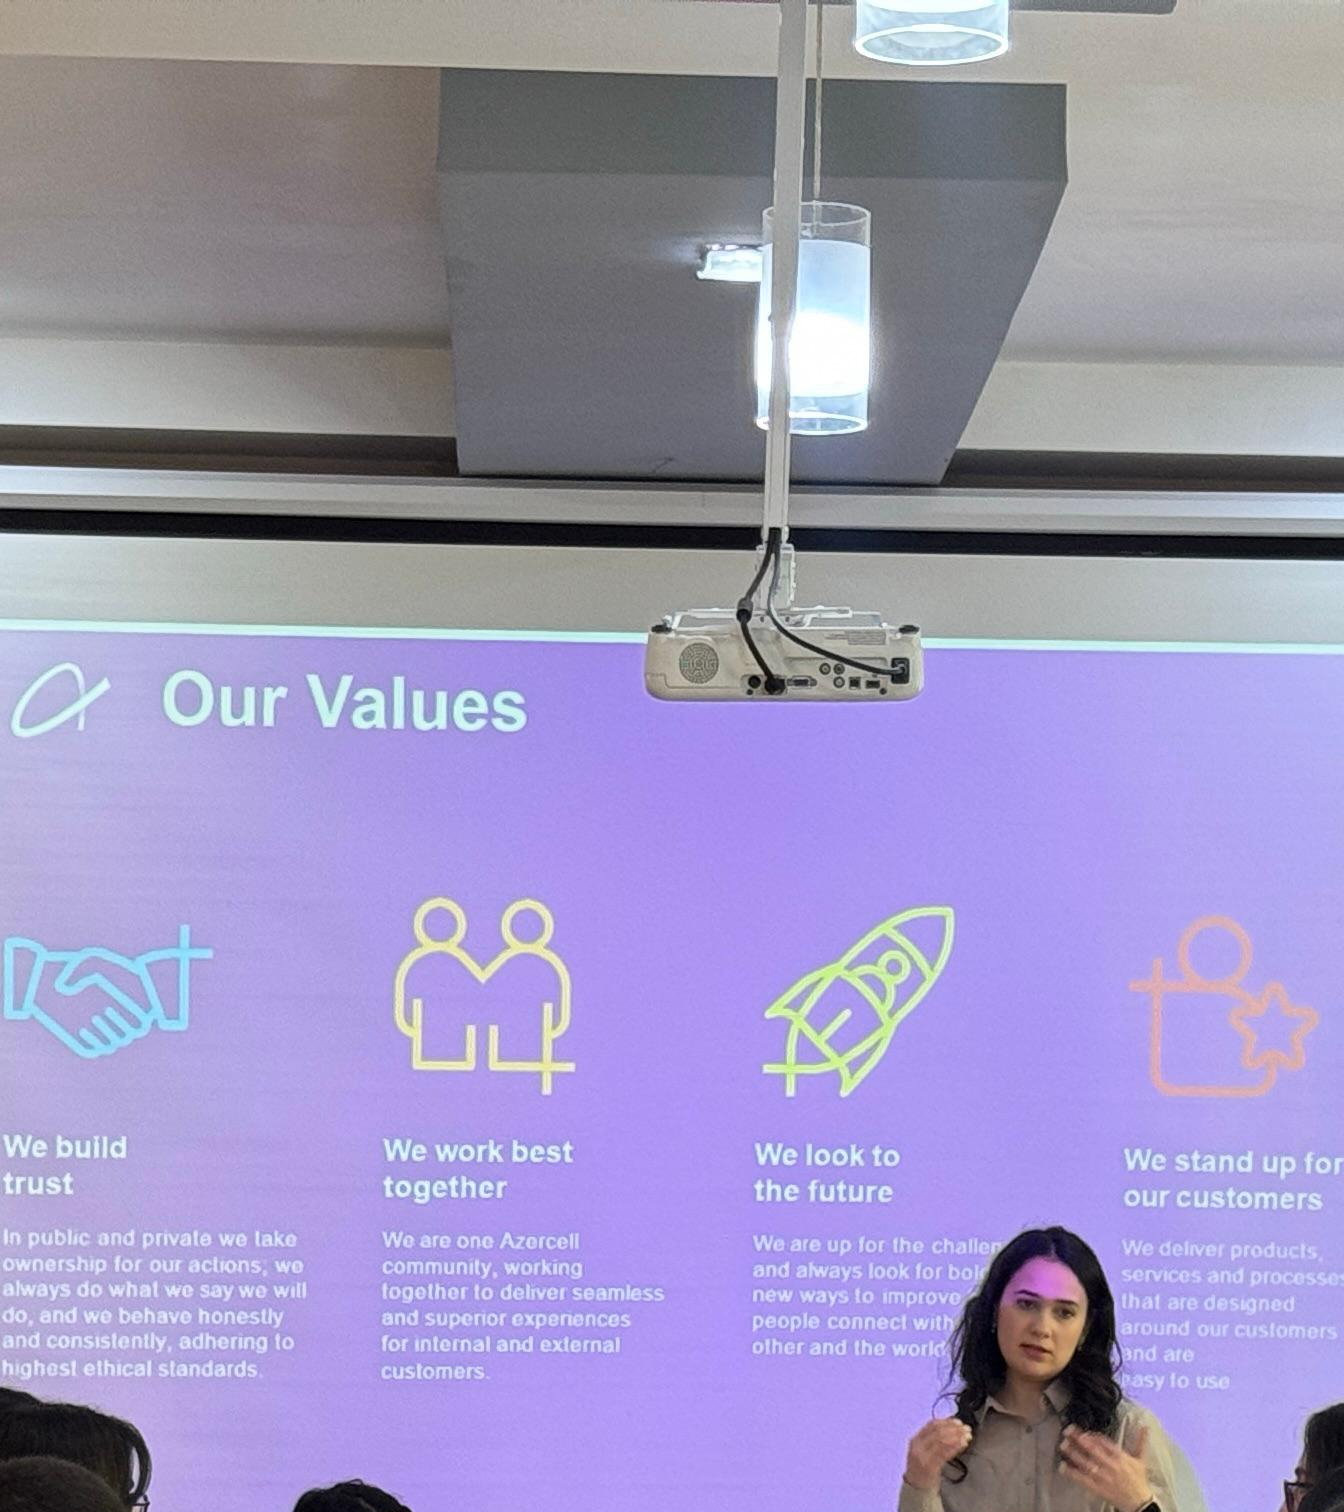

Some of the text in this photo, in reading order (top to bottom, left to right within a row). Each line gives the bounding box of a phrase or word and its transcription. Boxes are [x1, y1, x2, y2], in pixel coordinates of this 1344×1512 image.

[163, 670, 527, 732] Our Values
[4, 1135, 127, 1159] We build
[383, 1139, 573, 1163] We work best
[755, 1143, 900, 1167] We look to
[1124, 1149, 1344, 1179] We stand up for
[4, 1172, 74, 1195] trust
[383, 1176, 507, 1204] together
[755, 1179, 894, 1203] the future
[1124, 1188, 1324, 1210] our customers
[4, 1229, 297, 1249] In public and private we take
[382, 1232, 579, 1250] We are one Azercell
[753, 1235, 784, 1251] We
[790, 1239, 820, 1252] are
[828, 1240, 851, 1256] up
[859, 1237, 885, 1252] for
[893, 1237, 924, 1253] the
[1122, 1240, 1153, 1256] We
[1159, 1241, 1224, 1258] deliver
[3, 1256, 106, 1275] ownership
[114, 1256, 141, 1272] for
[150, 1259, 181, 1273] our
[275, 1260, 304, 1274] we
[382, 1258, 583, 1280] community, working
[753, 1262, 790, 1278] and
[796, 1263, 863, 1282] always
[869, 1263, 908, 1280] look
[916, 1264, 943, 1280] for
[1121, 1268, 1202, 1284] services
[1208, 1268, 1244, 1285] and
[3, 1281, 306, 1301] always do what we say we will
[382, 1283, 665, 1304] together to deliver seamless
[753, 1288, 961, 1308] new ways to improve
[1121, 1294, 1295, 1315] that are designed
[2, 1307, 284, 1328] do, and we behave honestly
[382, 1310, 631, 1330] and superior experiences
[752, 1314, 954, 1333] people connect with
[1121, 1321, 1338, 1340] around our customers
[2, 1333, 294, 1353] and consistently, adhering to
[382, 1335, 620, 1353] for internal and external
[752, 1339, 805, 1355] other
[810, 1340, 847, 1355] and
[854, 1340, 885, 1356] the
[1122, 1347, 1194, 1362] and are
[2, 1360, 77, 1380] highest
[84, 1360, 152, 1377] ethical
[381, 1363, 490, 1380] customers.
[1122, 1373, 1230, 1391] easy to use
